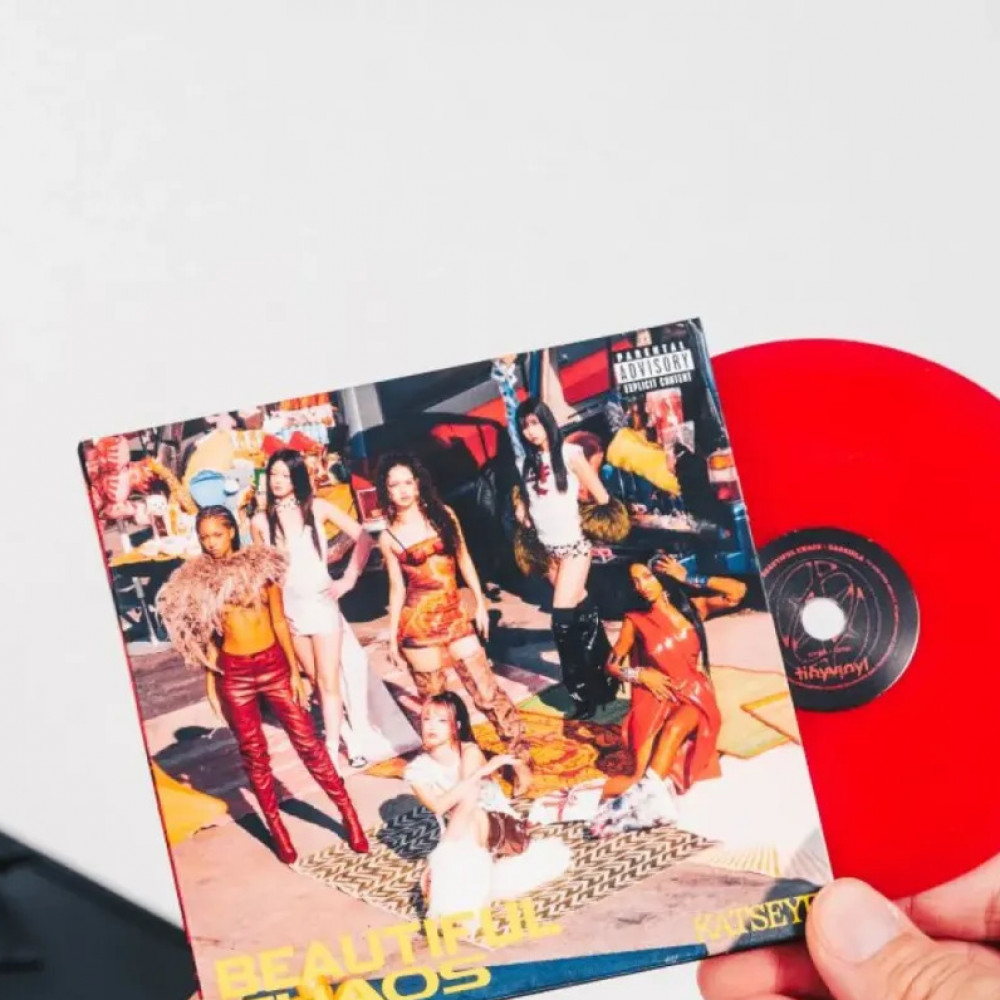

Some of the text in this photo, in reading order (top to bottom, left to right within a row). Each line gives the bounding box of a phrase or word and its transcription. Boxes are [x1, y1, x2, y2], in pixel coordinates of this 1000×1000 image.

[616, 341, 685, 362] PARENTAL
[620, 352, 690, 381] ADVISORY
[623, 372, 692, 394] EXPLICIT CONTENT
[794, 657, 869, 682] tinyvinyl
[214, 896, 564, 999] BEAUTIFUL
